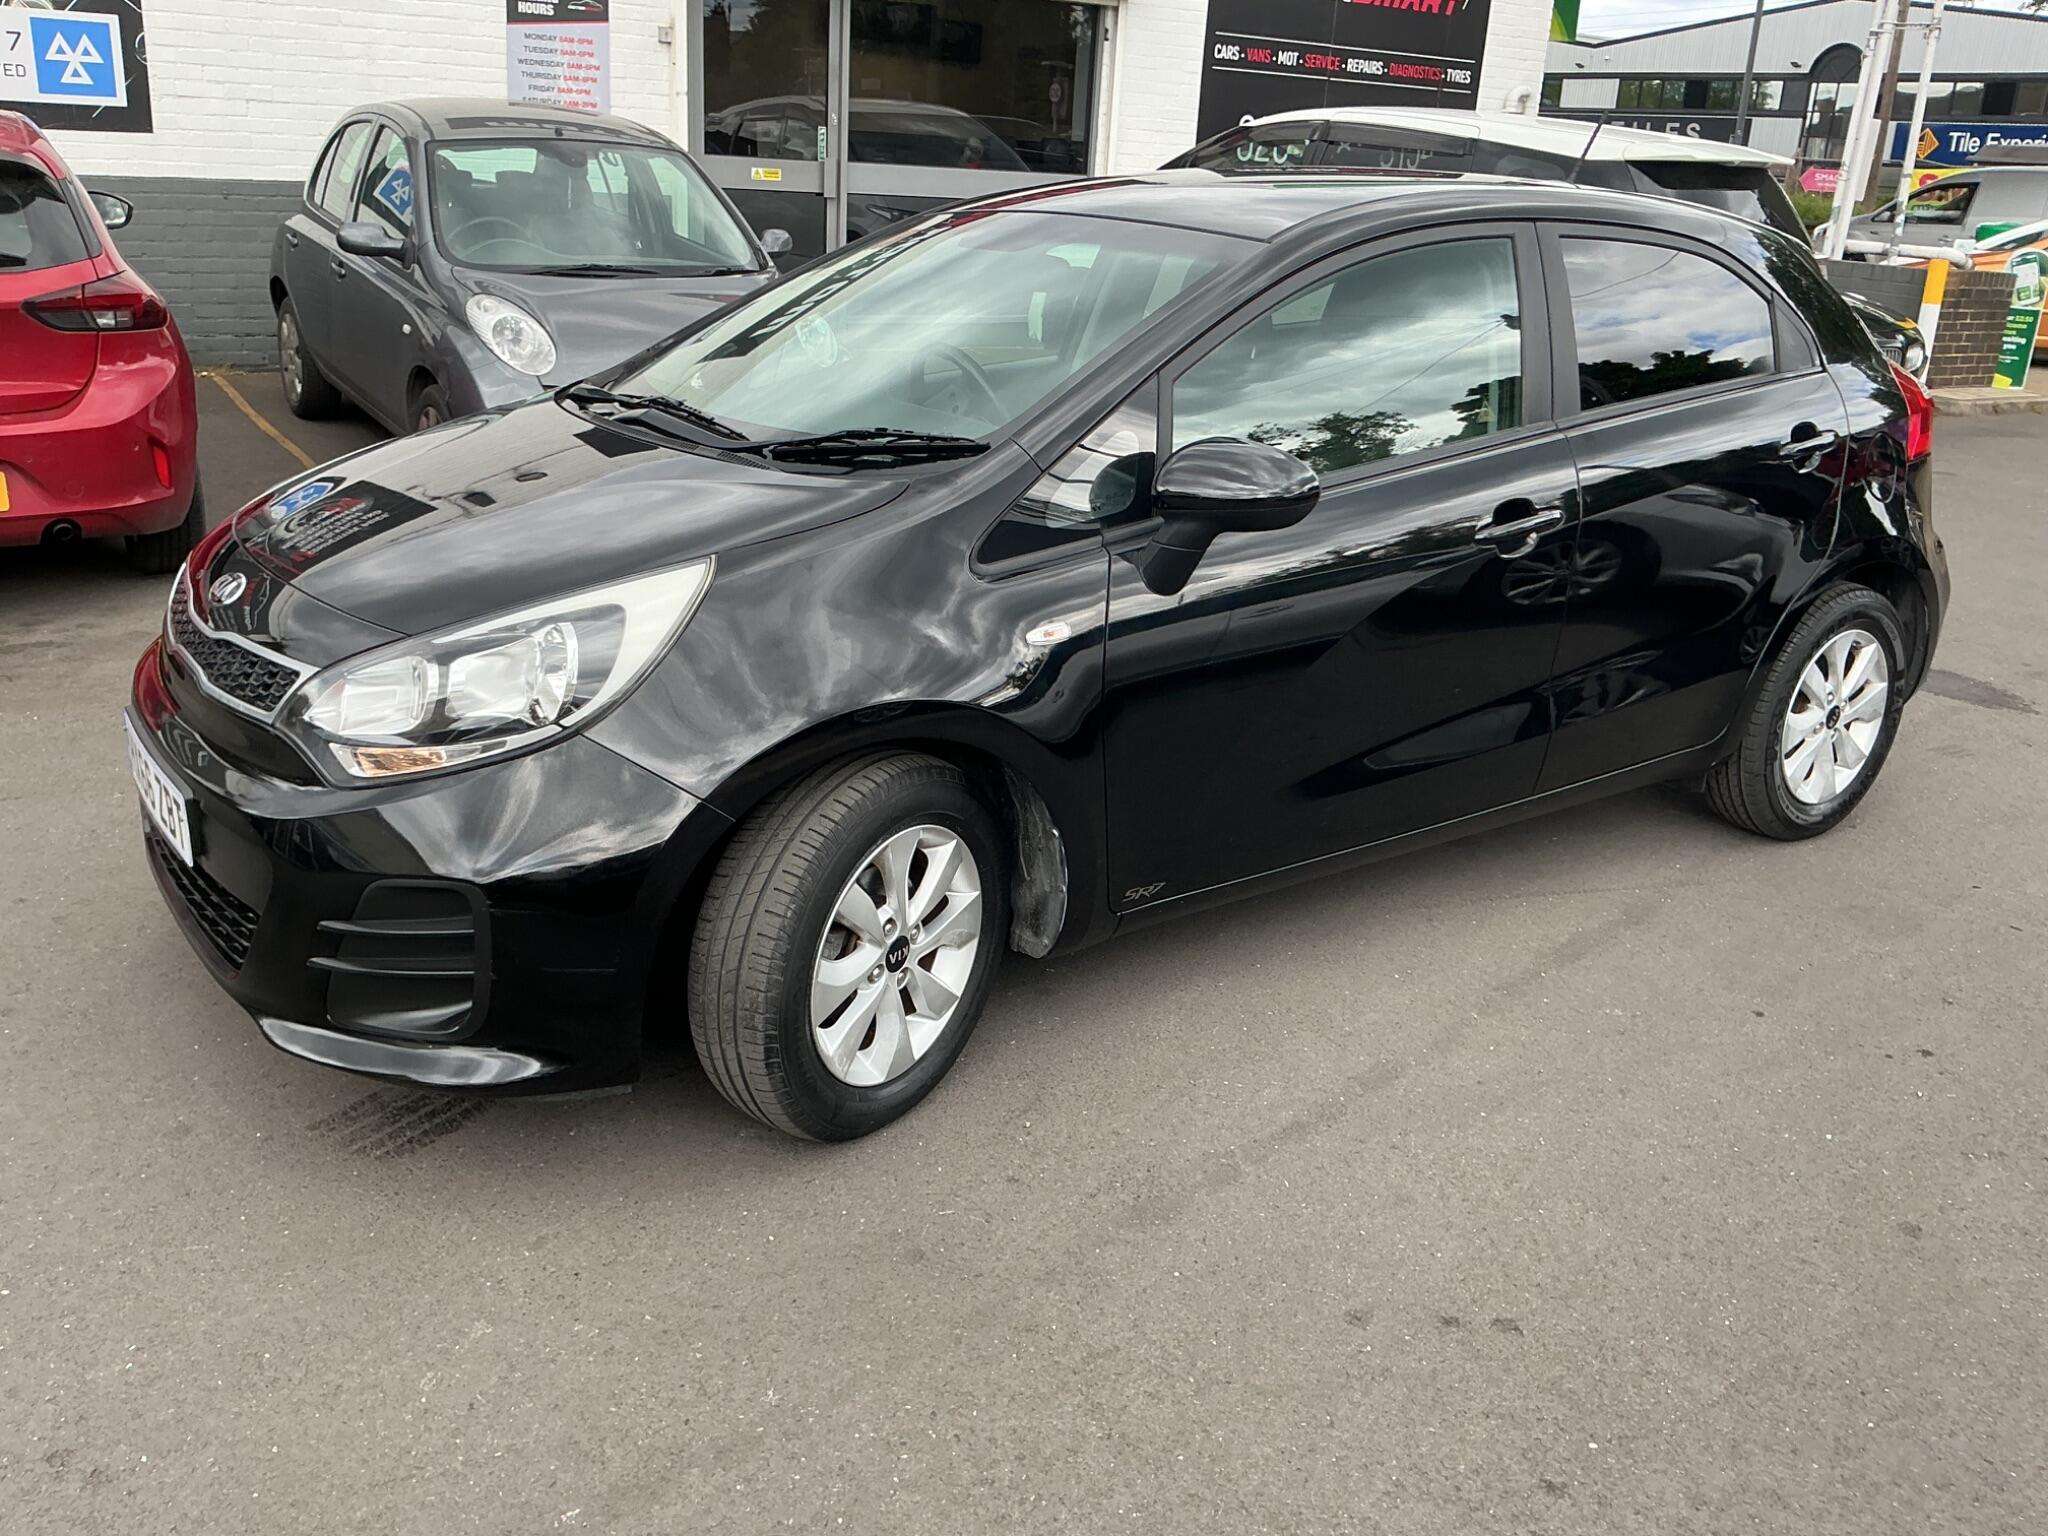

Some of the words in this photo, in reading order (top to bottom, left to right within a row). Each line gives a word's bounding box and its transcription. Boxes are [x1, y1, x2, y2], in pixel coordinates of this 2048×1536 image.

[517, 2, 555, 16] HOURS
[6, 30, 21, 51] 7
[523, 32, 558, 42] MONDAY
[523, 45, 559, 55] TUESDAY
[517, 58, 565, 68] WEDNESDAY
[1214, 43, 1240, 61] CARS
[1247, 47, 1272, 64] VANS
[1278, 50, 1300, 67] MOT
[1304, 53, 1341, 71] SERVICE
[1346, 58, 1384, 75] REPAIRS
[1389, 62, 1441, 81] DIAGNOSTICS
[1446, 68, 1472, 85] TYRES
[0, 63, 26, 78] ED
[521, 71, 562, 81] THURSDAY
[528, 84, 556, 93] FRIDAY
[1949, 131, 1981, 153] Tile
[1122, 882, 1167, 902] SR7
